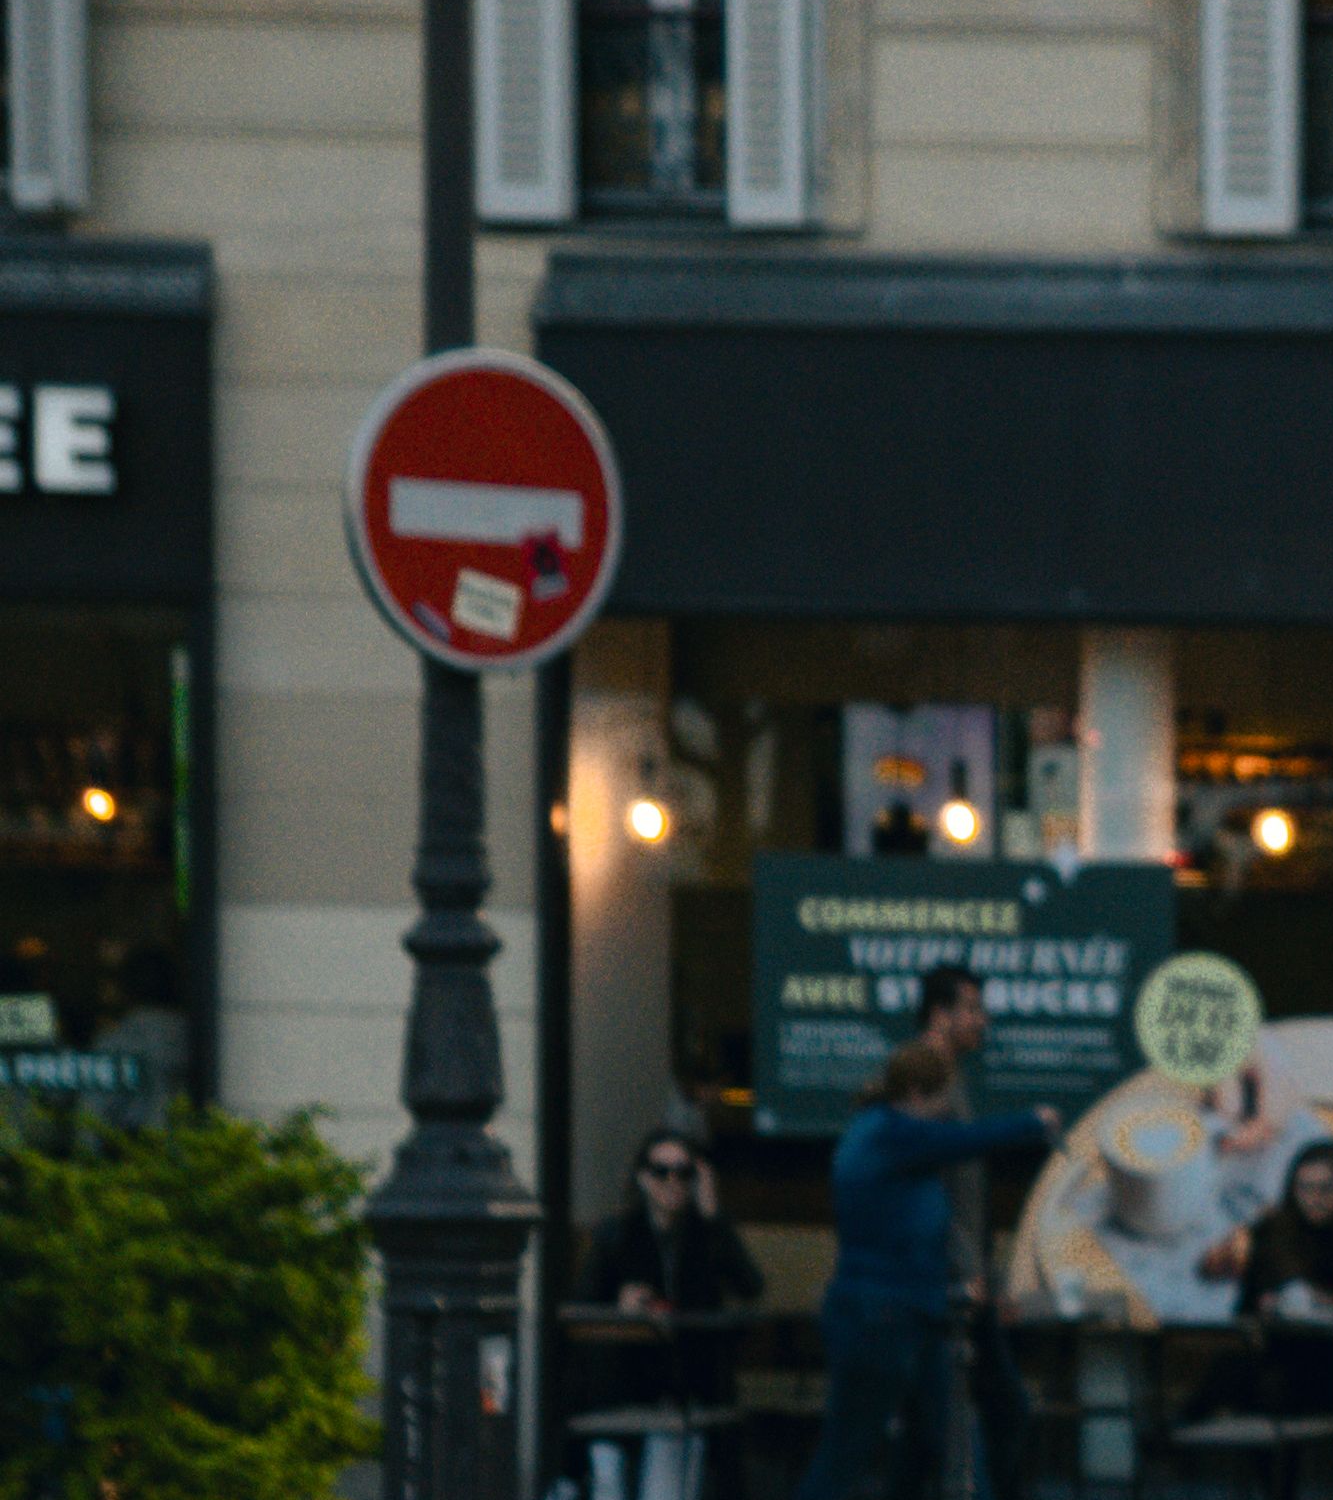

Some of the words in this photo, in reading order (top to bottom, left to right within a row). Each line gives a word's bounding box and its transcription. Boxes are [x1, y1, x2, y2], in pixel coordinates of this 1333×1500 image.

[0, 383, 120, 497] E
[780, 973, 868, 1012] AVEC
[874, 976, 1121, 1017] STBUCKS
